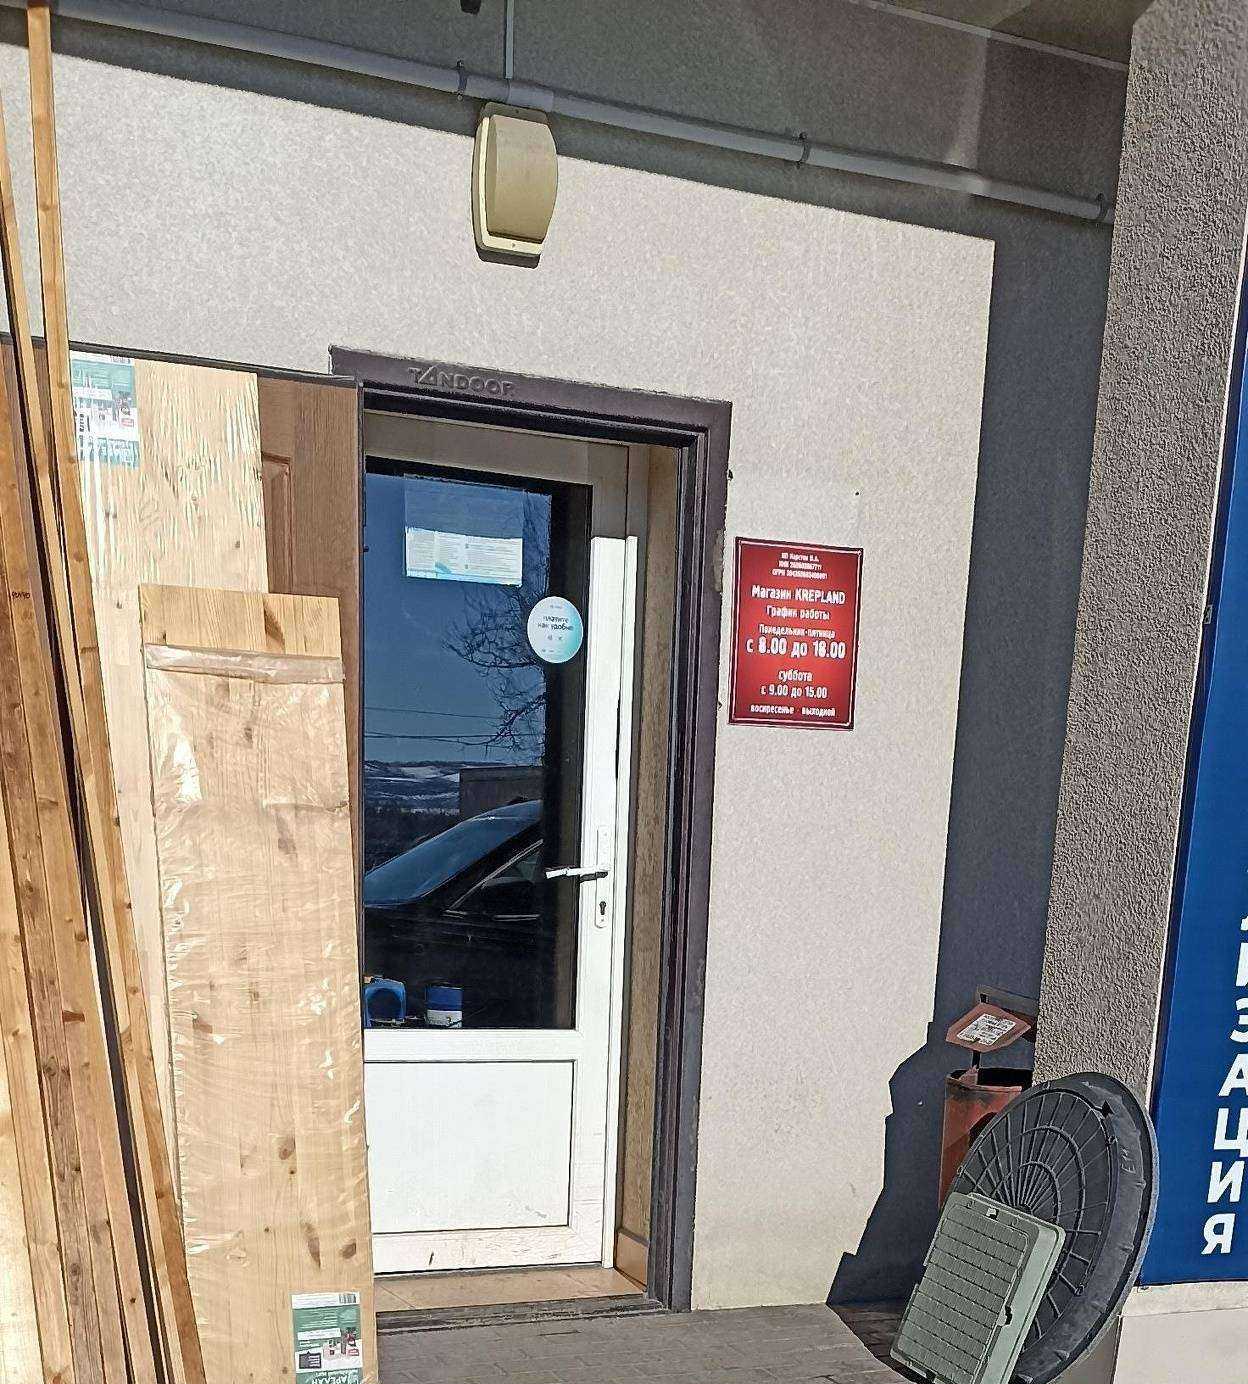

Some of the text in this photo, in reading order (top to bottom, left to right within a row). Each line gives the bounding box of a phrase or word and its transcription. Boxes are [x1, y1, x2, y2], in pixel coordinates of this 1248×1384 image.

[751, 584, 846, 605] Магазин KREPLAND
[766, 605, 831, 620] График работы
[758, 636, 788, 655] 8.00
[790, 641, 808, 658] до
[812, 640, 846, 659] 18.00
[778, 669, 813, 682] суббота
[768, 684, 789, 697] 9.00
[790, 687, 803, 698] до
[804, 685, 828, 699] 15.00
[801, 706, 836, 717] выходной
